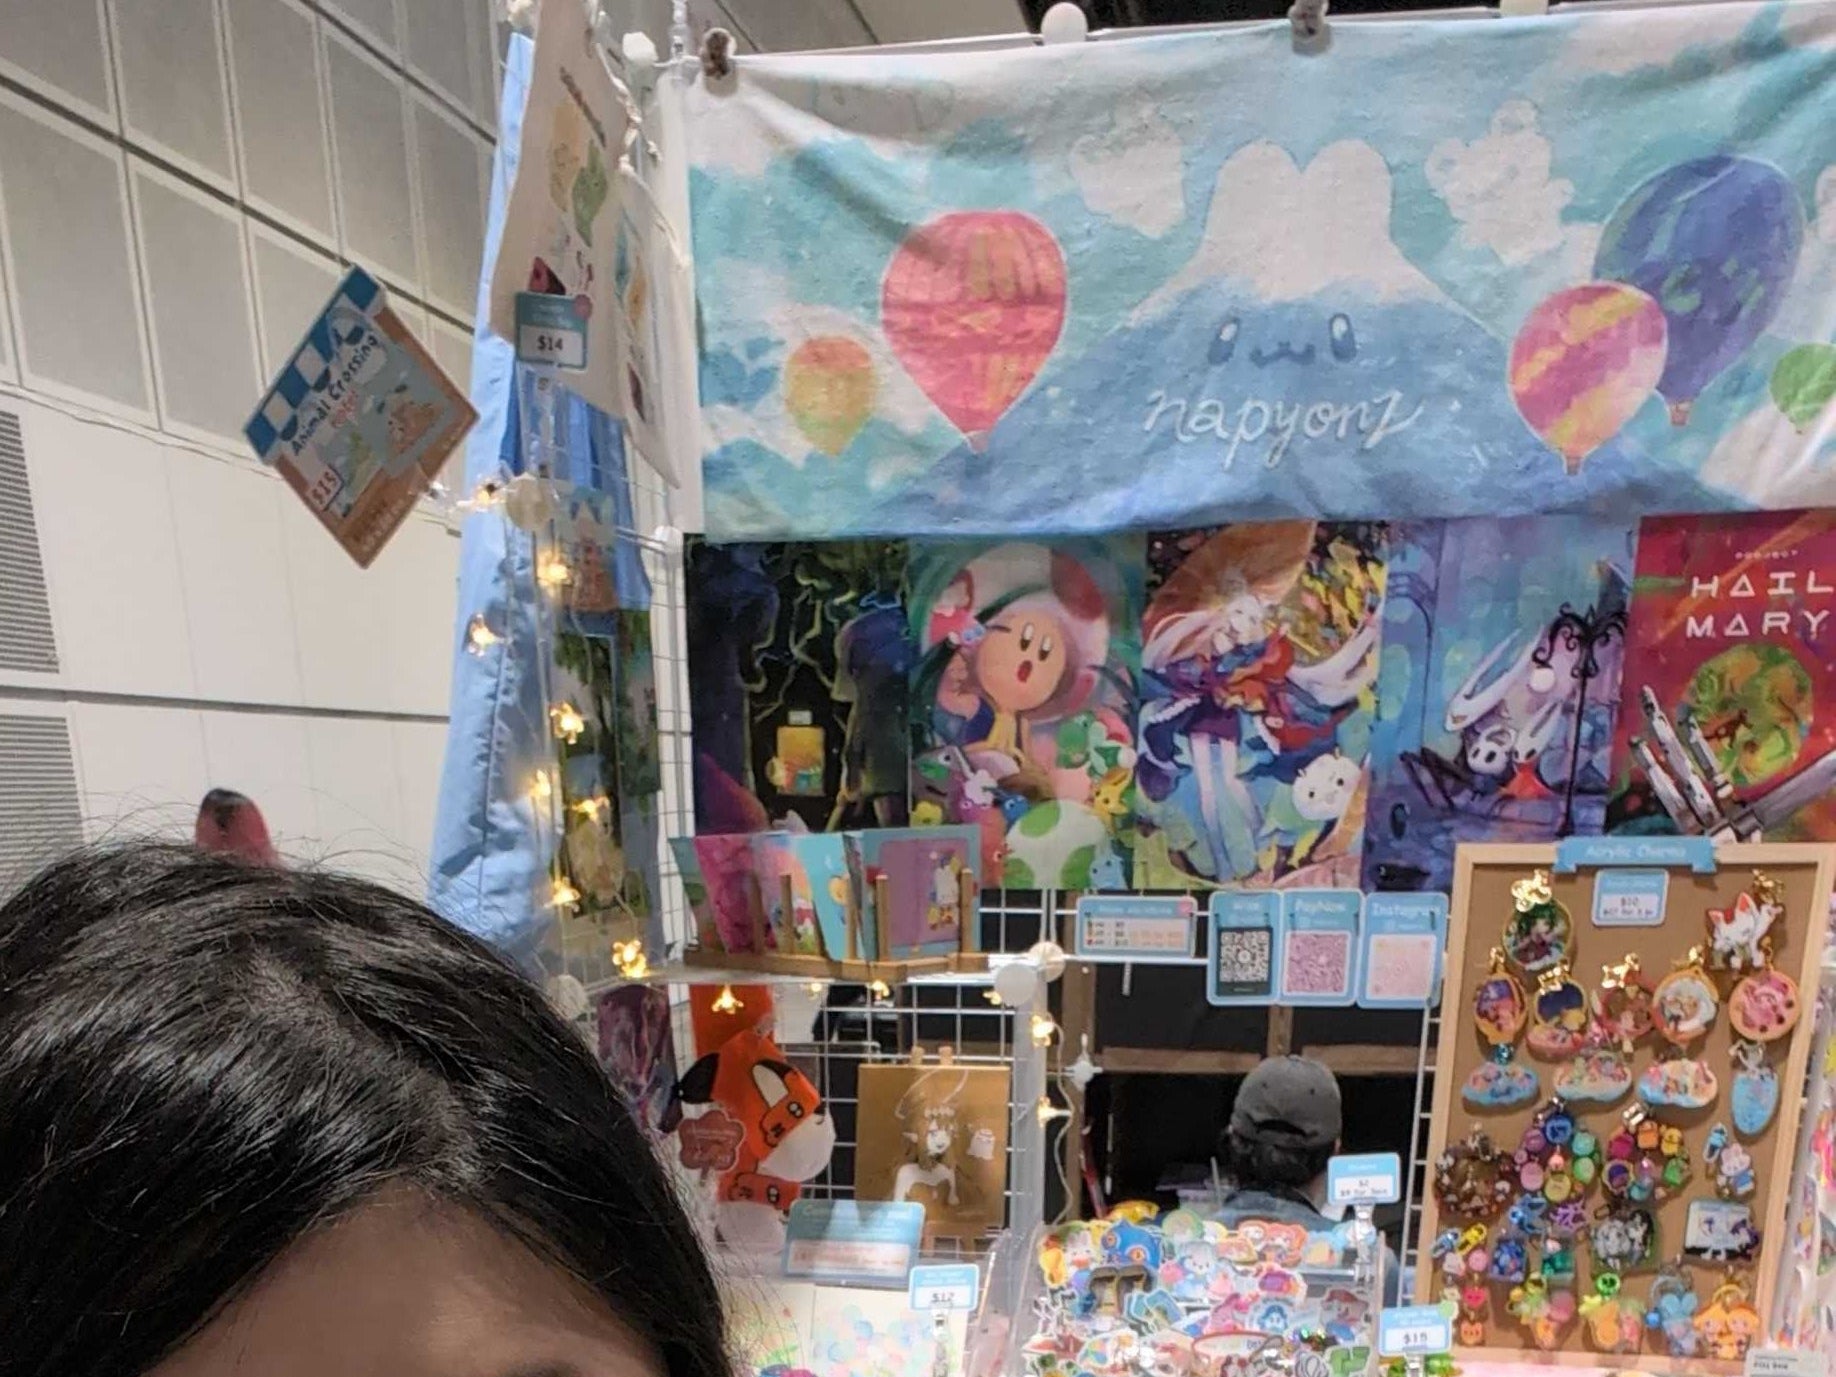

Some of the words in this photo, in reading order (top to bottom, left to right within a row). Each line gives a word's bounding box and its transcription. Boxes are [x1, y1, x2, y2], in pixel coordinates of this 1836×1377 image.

[537, 335, 563, 351] $14
[290, 399, 331, 457] Animal
[328, 335, 379, 400] Crossing
